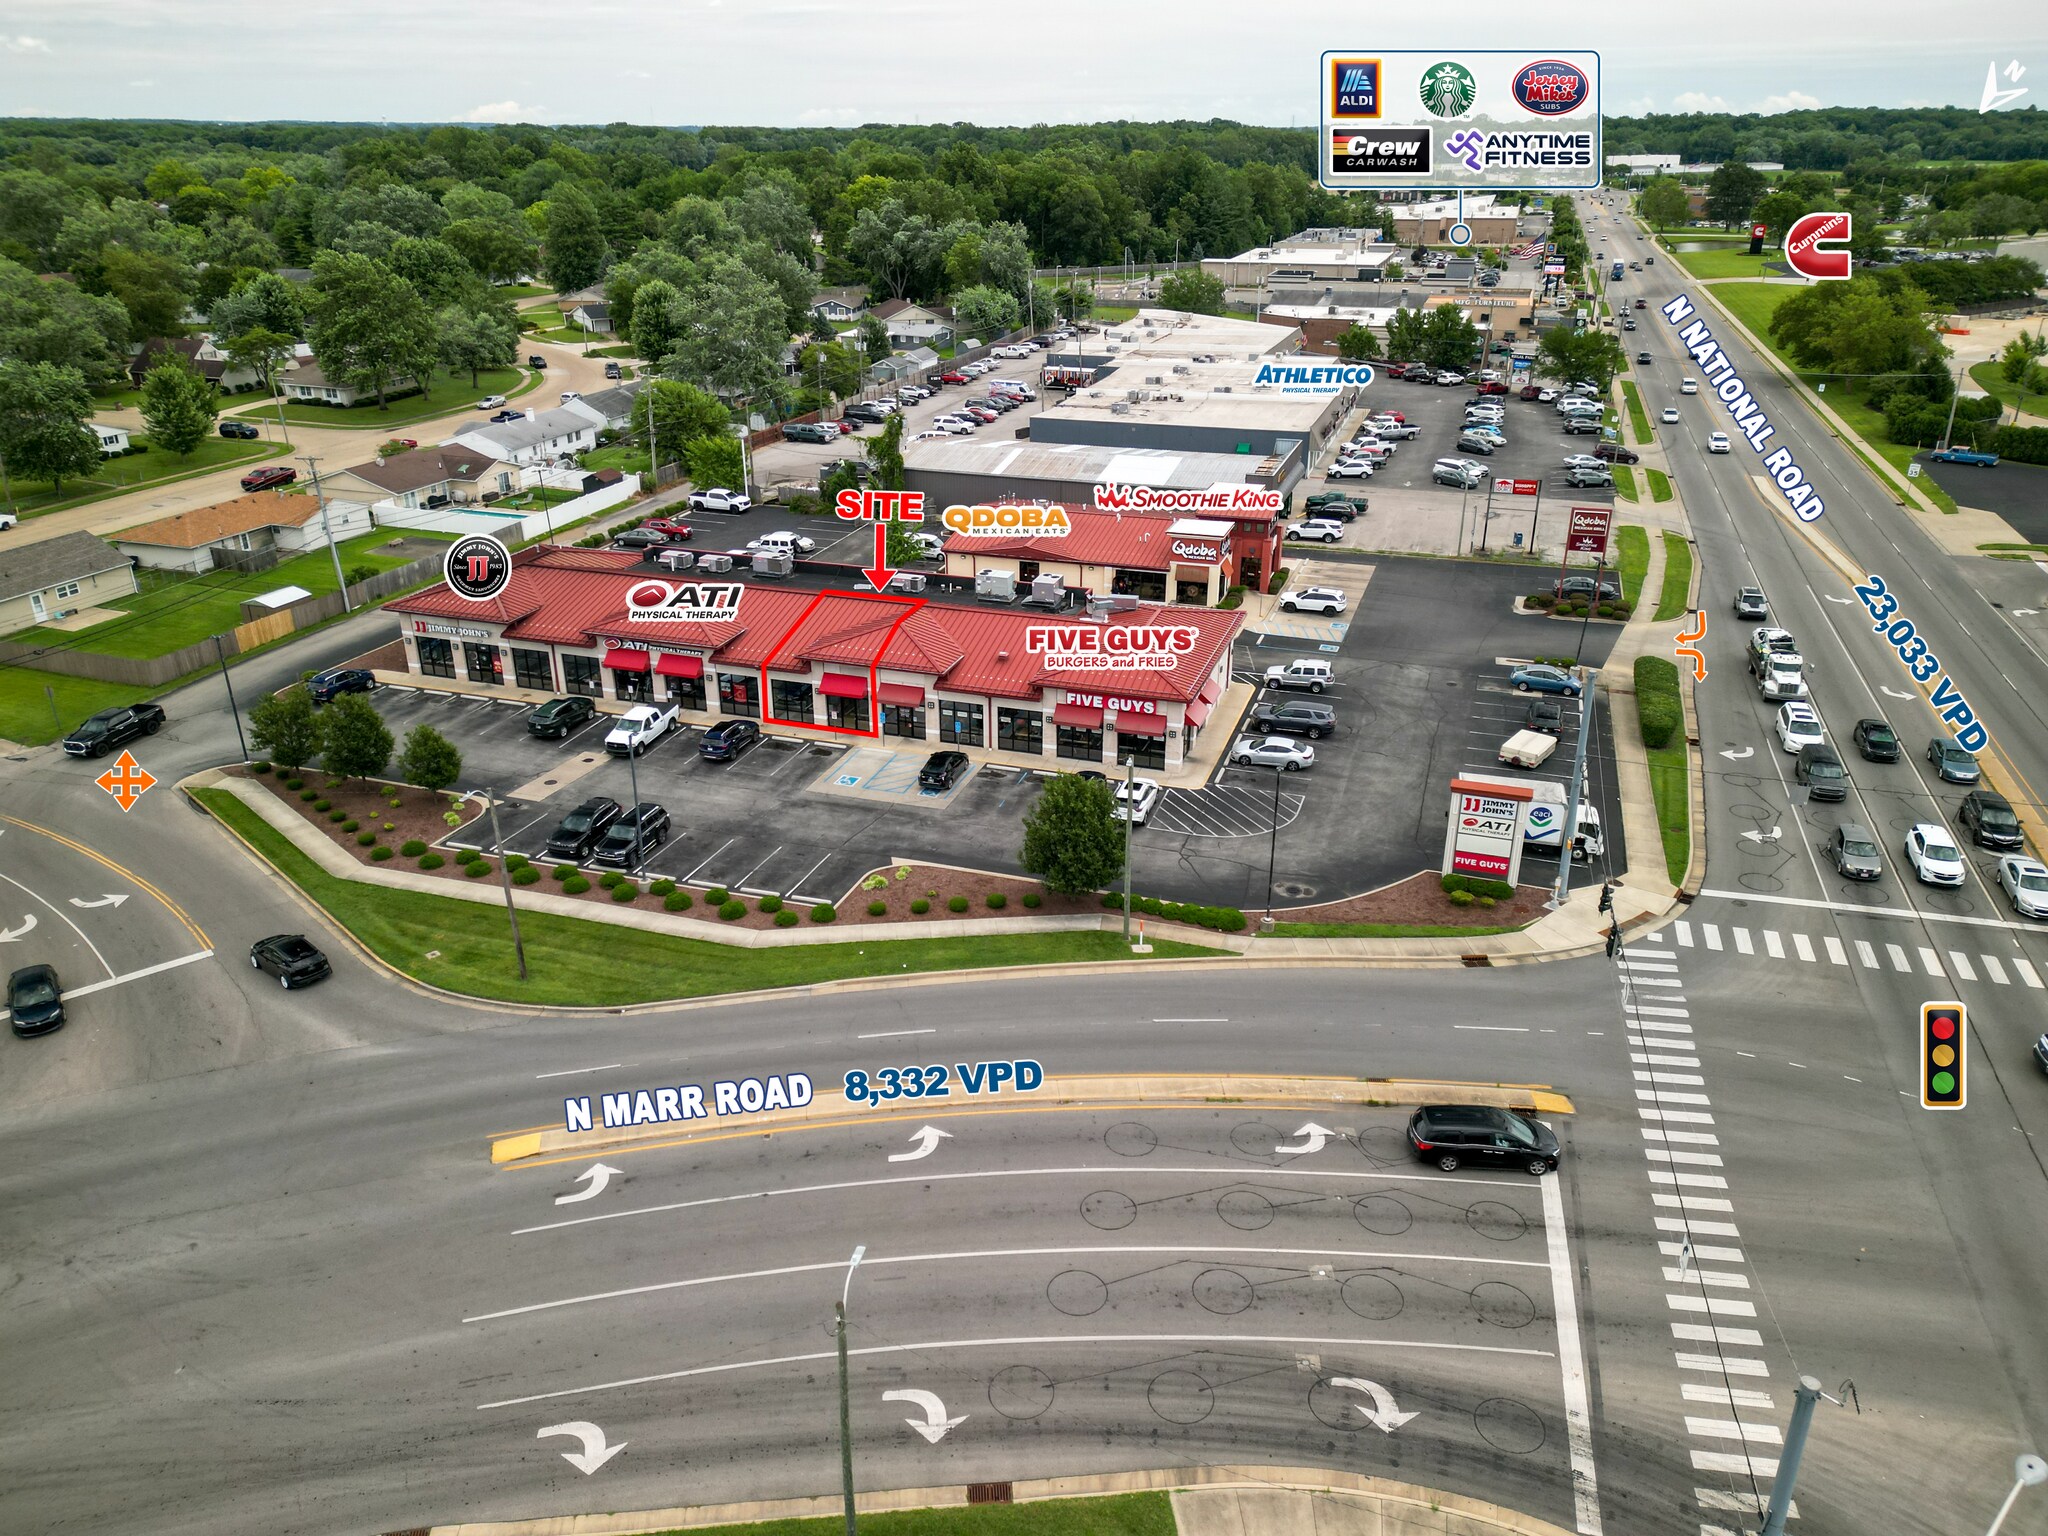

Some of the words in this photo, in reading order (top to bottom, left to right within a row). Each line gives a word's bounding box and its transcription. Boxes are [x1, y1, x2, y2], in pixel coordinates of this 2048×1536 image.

[1574, 515, 1606, 526] Qdoba
[1171, 540, 1217, 558] Qdoba
[428, 624, 456, 634] JIMMY
[458, 628, 489, 638] JOHN'S
[623, 641, 648, 651] ATI
[1067, 692, 1103, 708] FIVE
[1107, 697, 1155, 713] GUYS
[1463, 798, 1481, 812] JJ
[1482, 800, 1515, 808] JIMMY
[1482, 807, 1514, 816] JOHN'S
[1478, 821, 1512, 832] ATI
[1455, 857, 1477, 866] FIVE
[1479, 860, 1507, 870] GUYS
